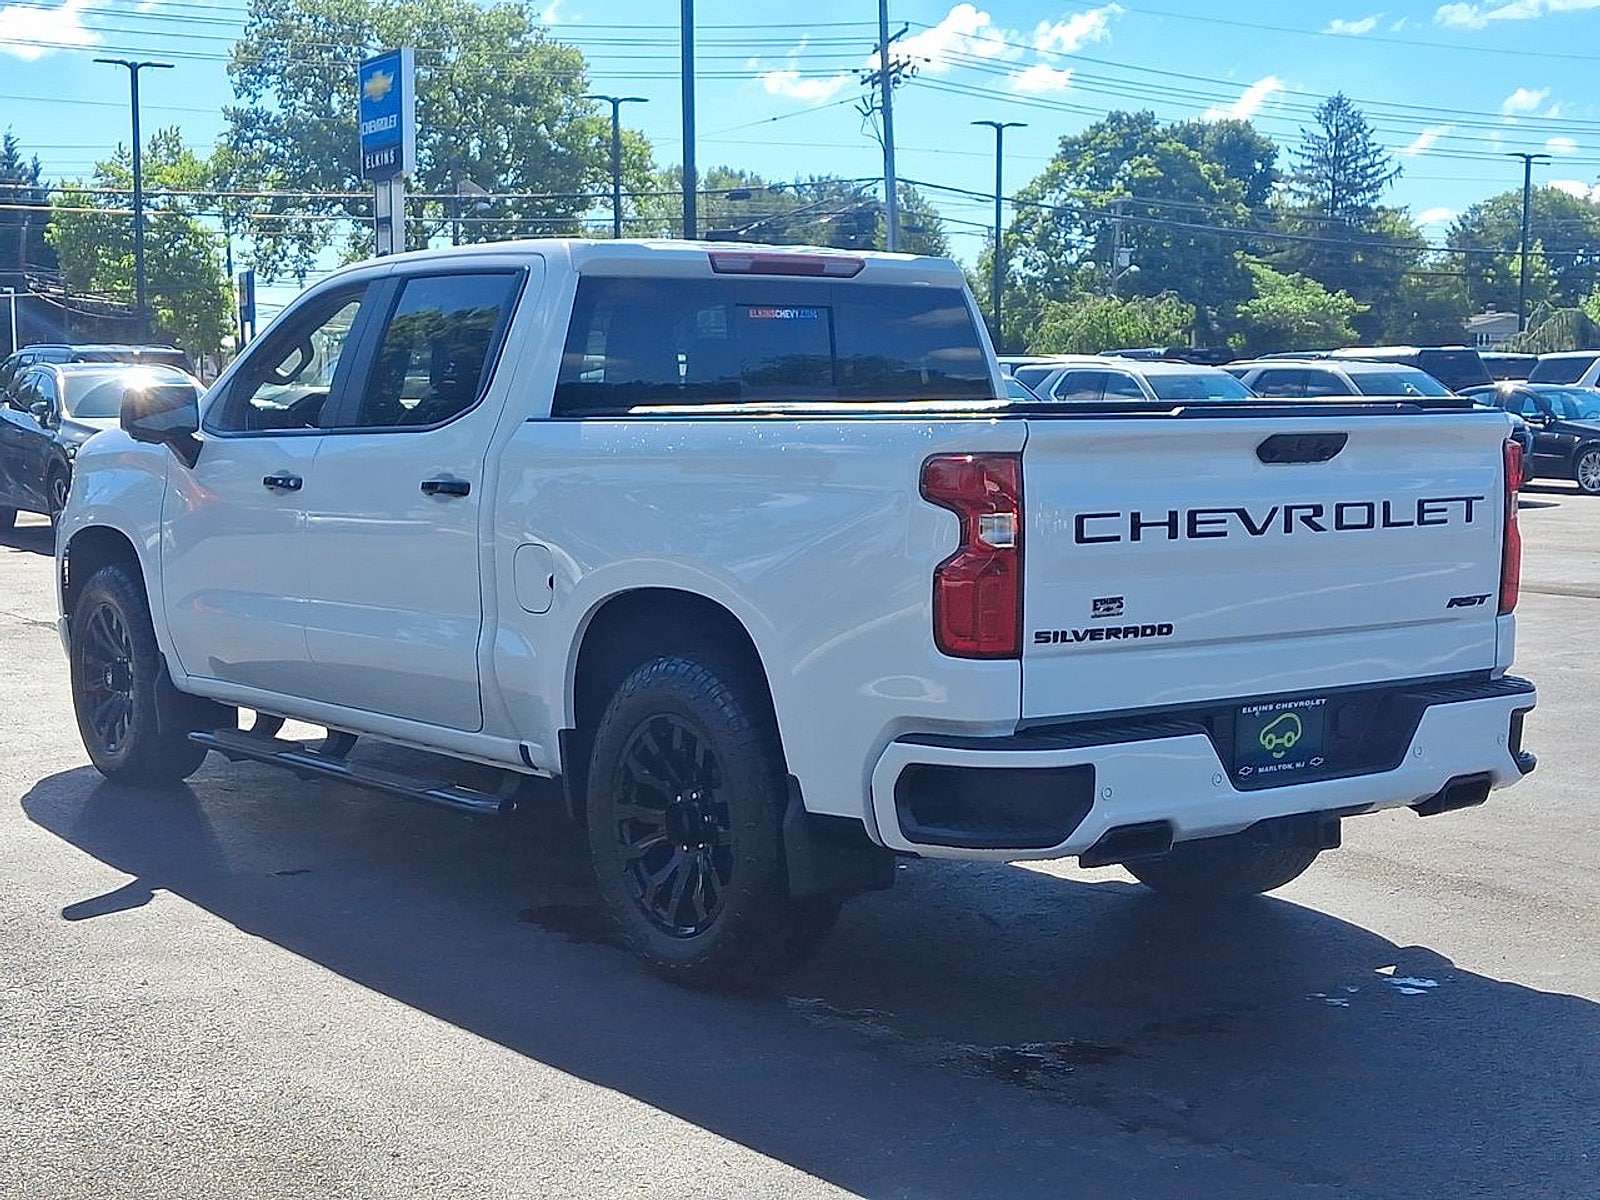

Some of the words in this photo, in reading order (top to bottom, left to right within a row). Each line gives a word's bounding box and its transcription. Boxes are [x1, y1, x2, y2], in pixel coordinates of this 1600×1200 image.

[366, 150, 395, 169] ELKINS
[1075, 497, 1484, 544] CHEVROLET
[1446, 593, 1493, 608] RST
[1034, 624, 1174, 643] SILVERADO
[1242, 705, 1274, 714] ELKINS
[1275, 699, 1327, 710] CHEVROLET
